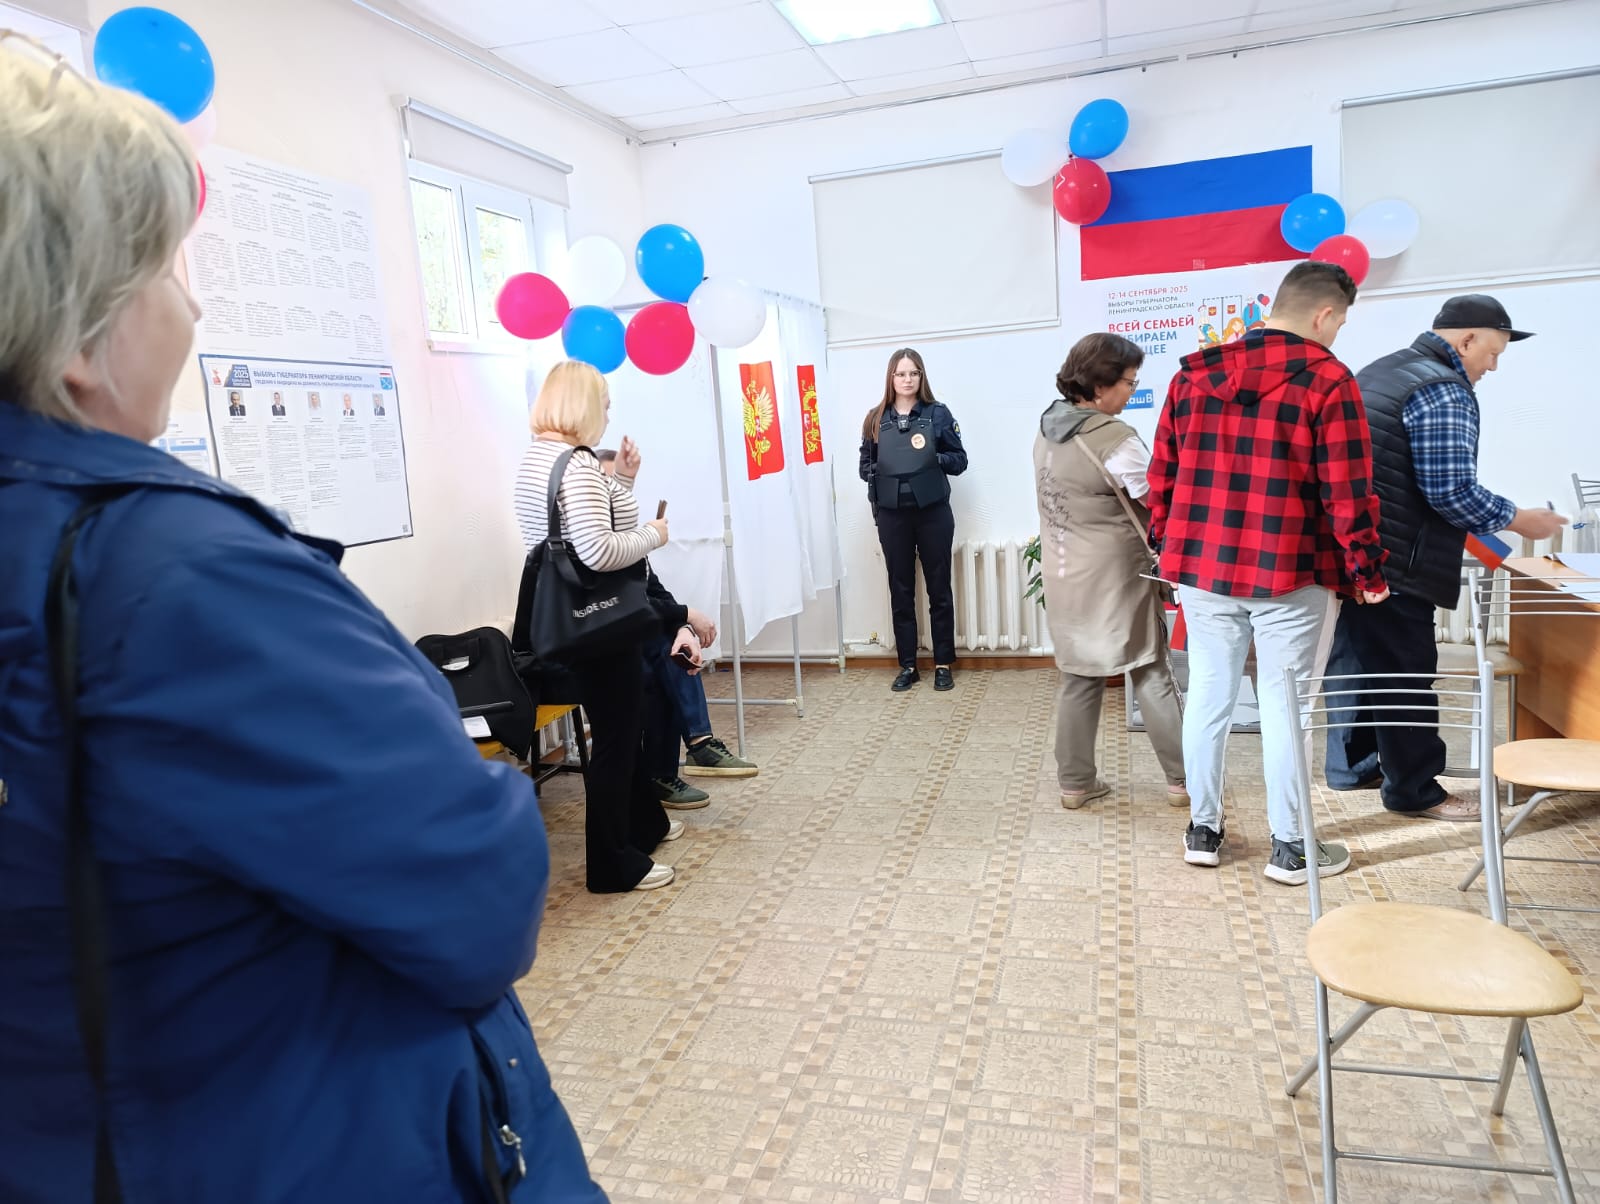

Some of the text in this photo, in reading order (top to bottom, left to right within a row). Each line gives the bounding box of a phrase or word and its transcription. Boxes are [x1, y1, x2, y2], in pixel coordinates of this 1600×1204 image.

[1128, 287, 1168, 298] СЕНТЯБРЯ
[1169, 285, 1188, 294] 2025
[1108, 296, 1178, 308] ВЫБОРЫ ГУБЕРНАТОРА
[1108, 302, 1194, 315] ЛЕНИНГРАДСКОЙ ОБЛАСТИ
[1108, 314, 1195, 333] ВСЕЙ СЕМЬЕЙ
[1124, 331, 1178, 343] БИРАЕМ
[572, 596, 620, 618] INSIDE OUT
